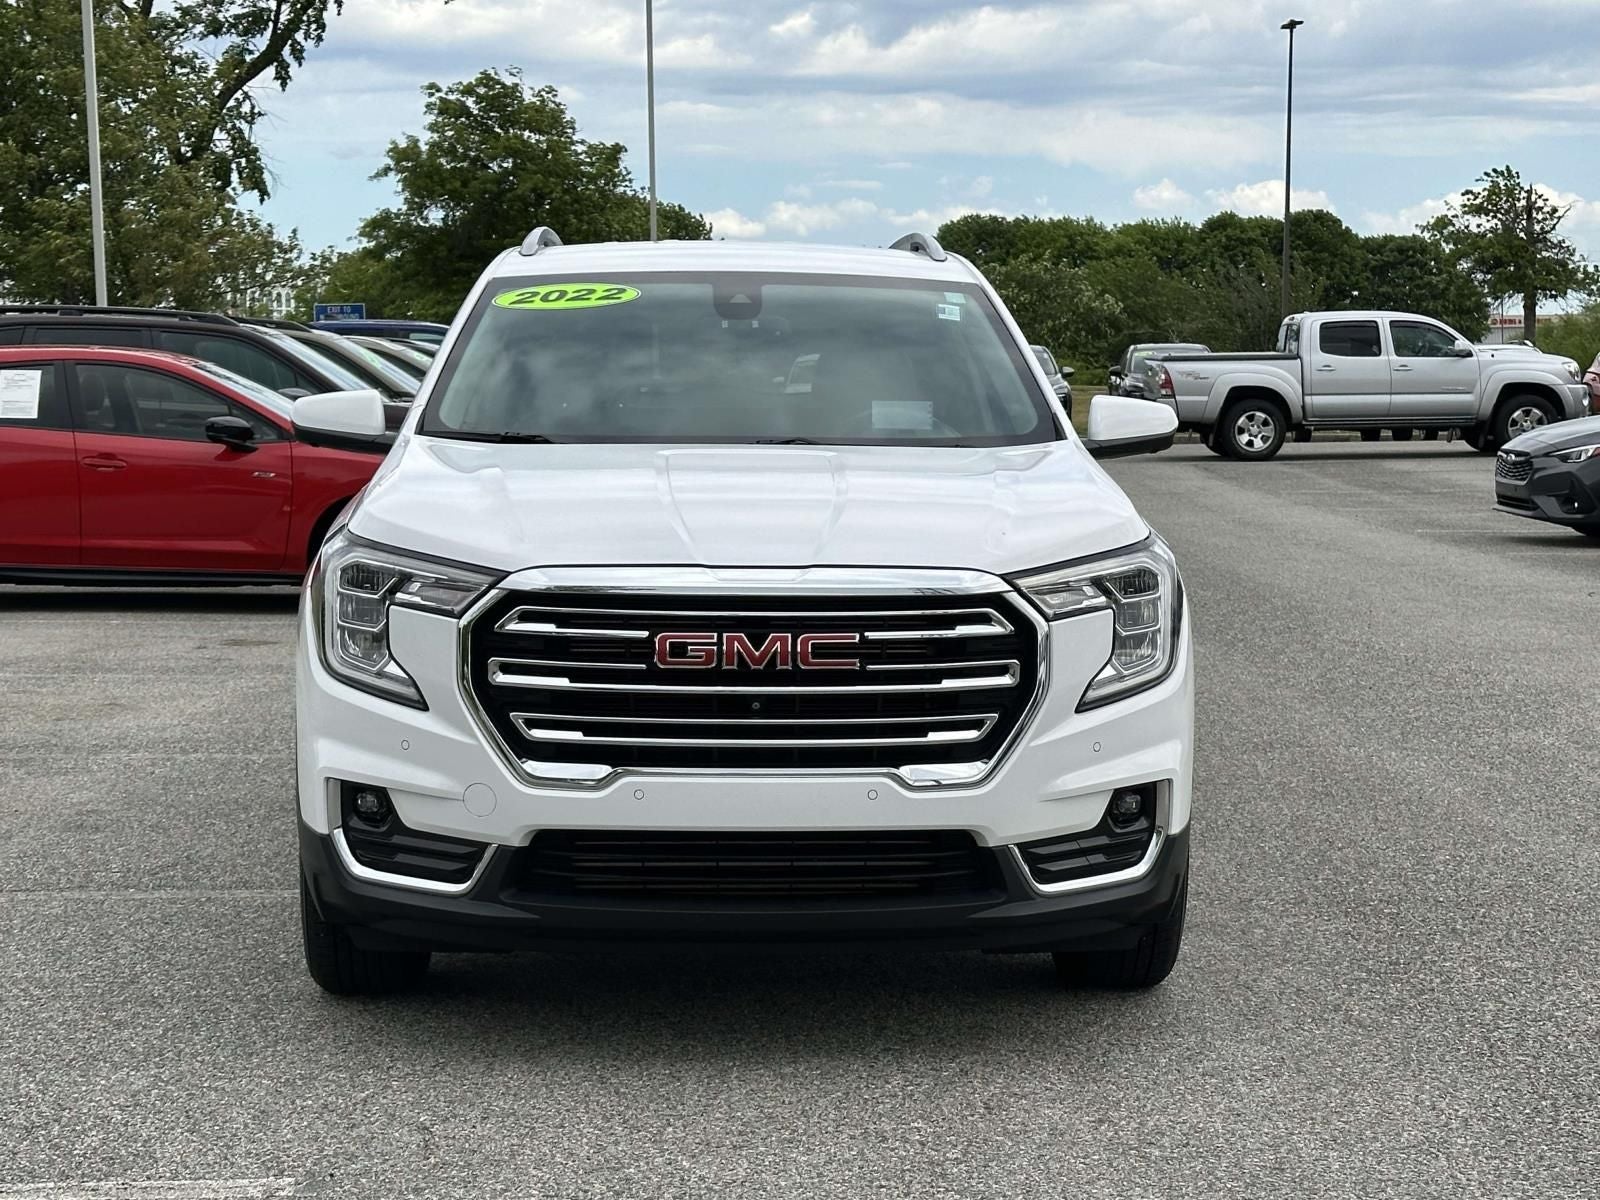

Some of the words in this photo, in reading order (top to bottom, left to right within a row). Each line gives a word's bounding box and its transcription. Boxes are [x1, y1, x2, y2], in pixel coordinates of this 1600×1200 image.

[508, 287, 627, 306] 2022
[343, 305, 351, 313] TO
[655, 632, 860, 669] GMC
